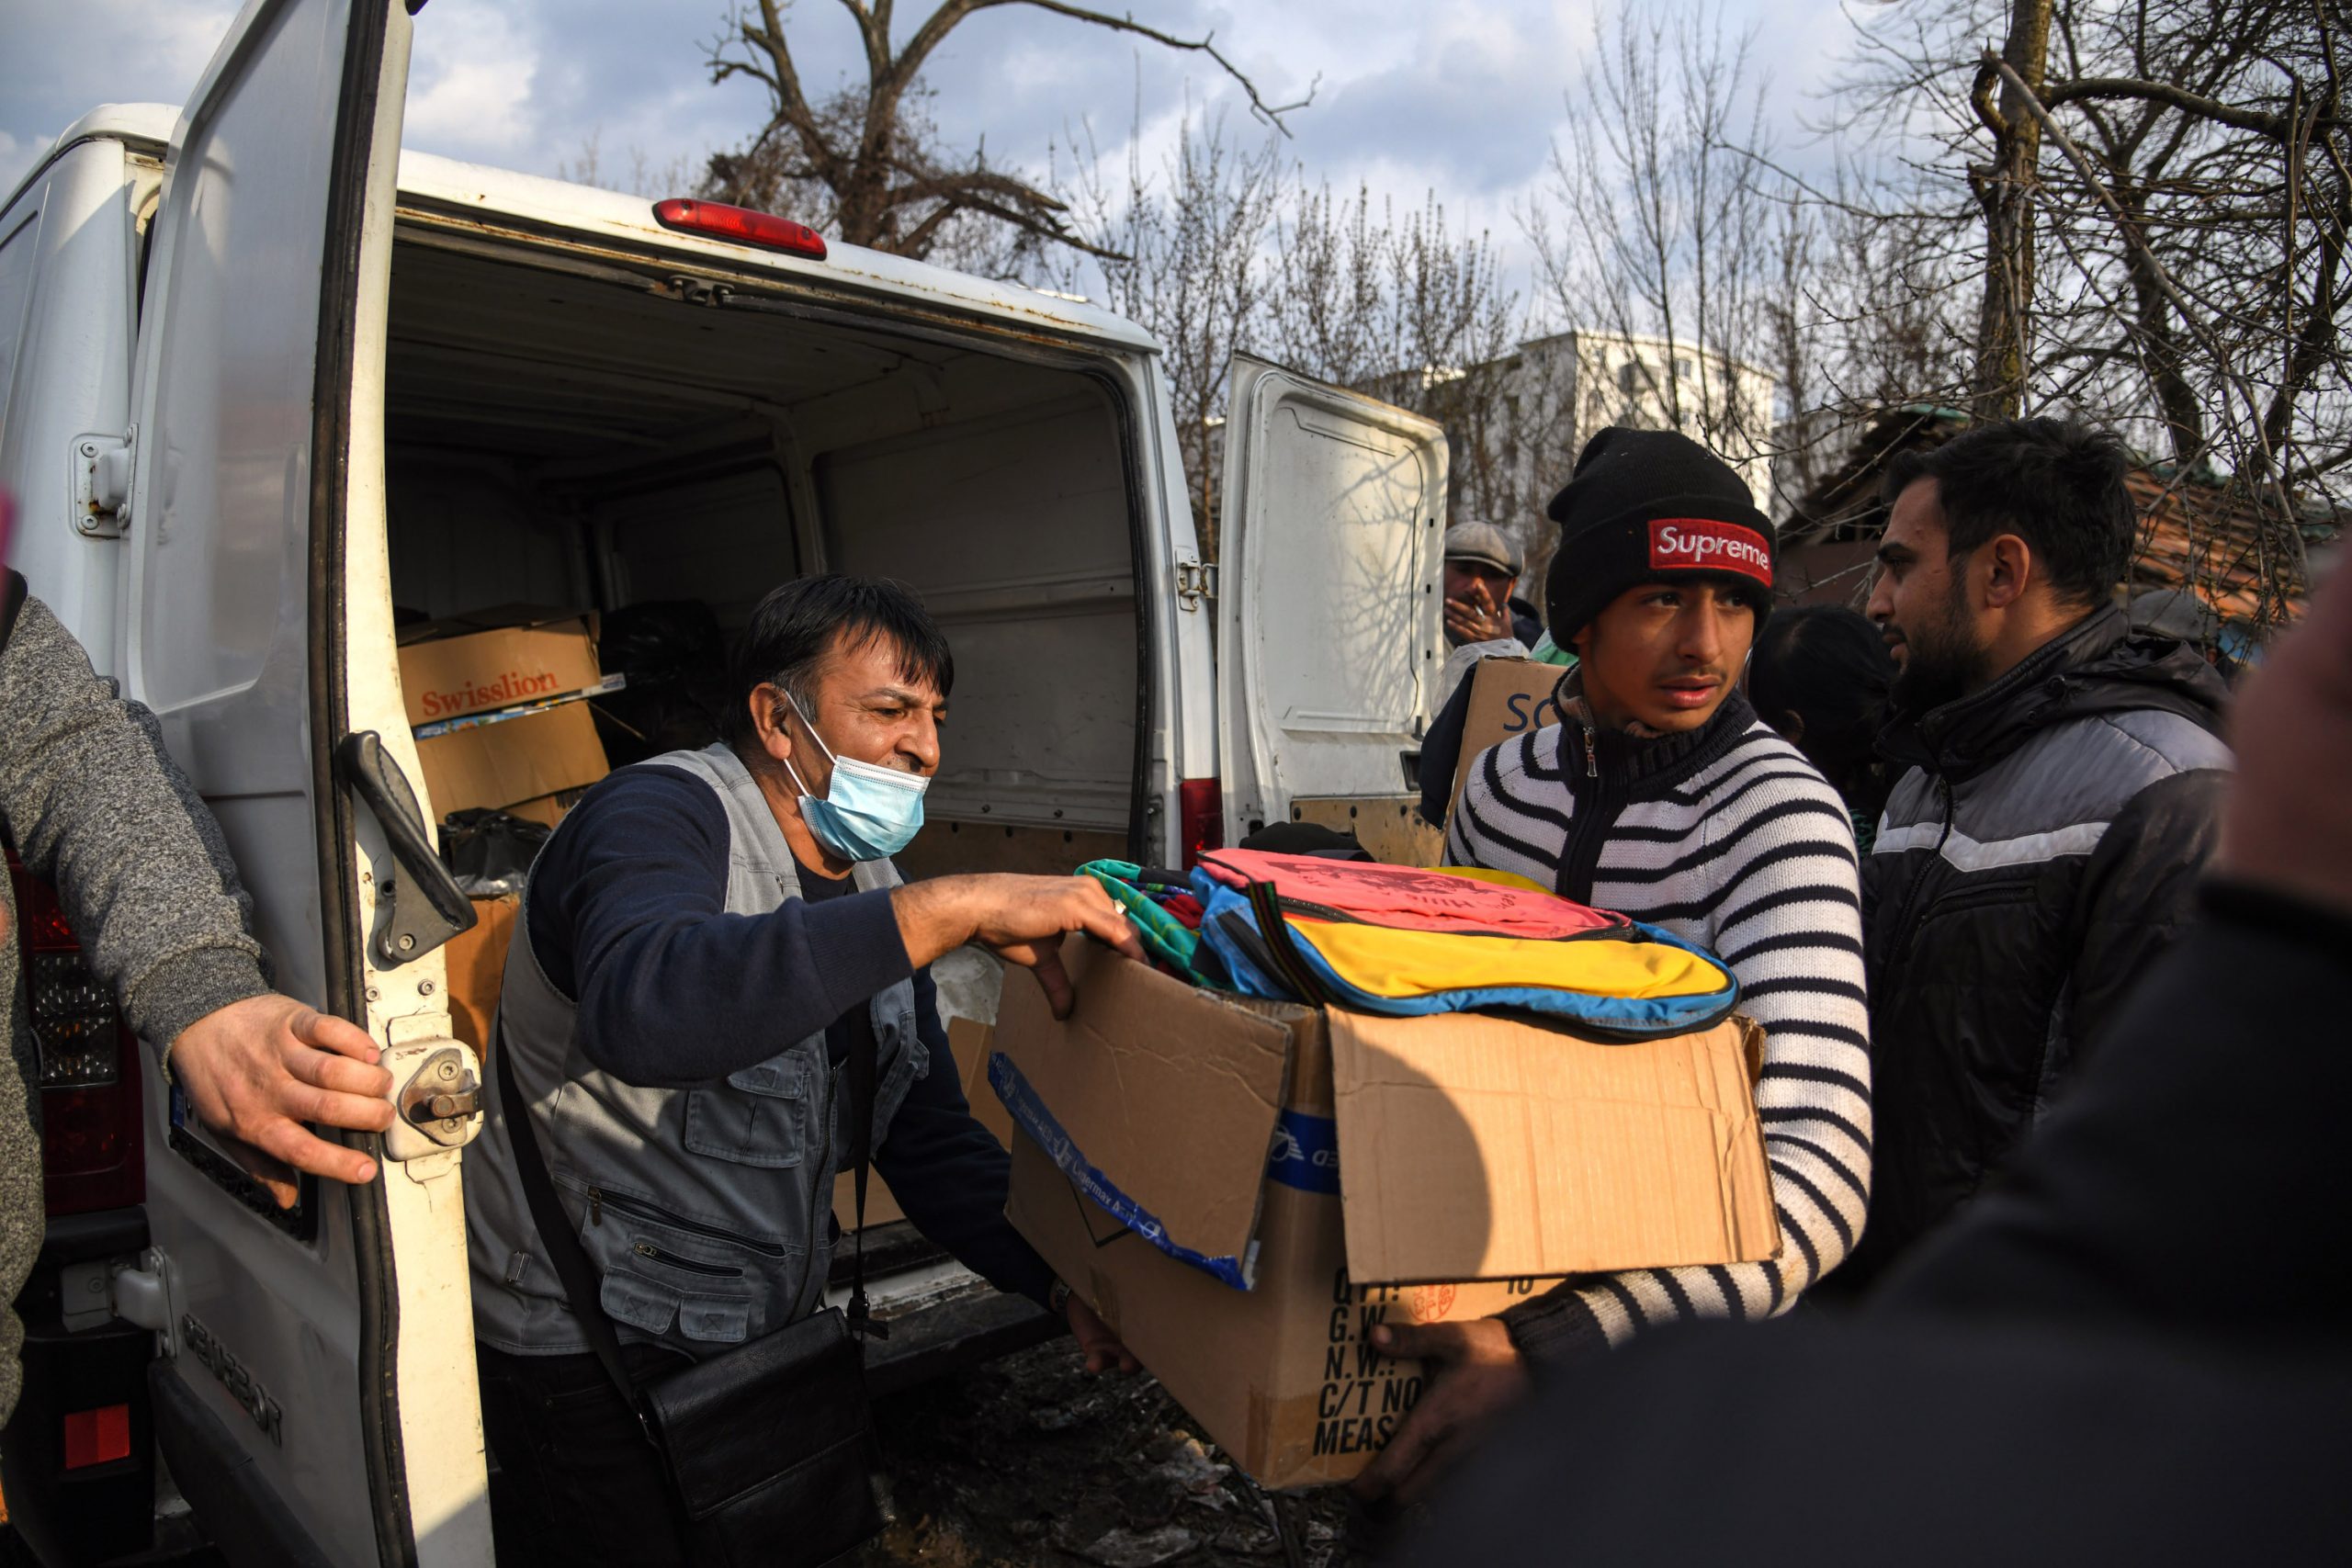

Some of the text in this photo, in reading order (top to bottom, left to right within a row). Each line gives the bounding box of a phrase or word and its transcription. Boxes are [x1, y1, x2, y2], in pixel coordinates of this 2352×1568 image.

[1657, 525, 1770, 570] Supreme
[421, 671, 560, 717] Swisslion
[1318, 1381, 1374, 1420] C/T
